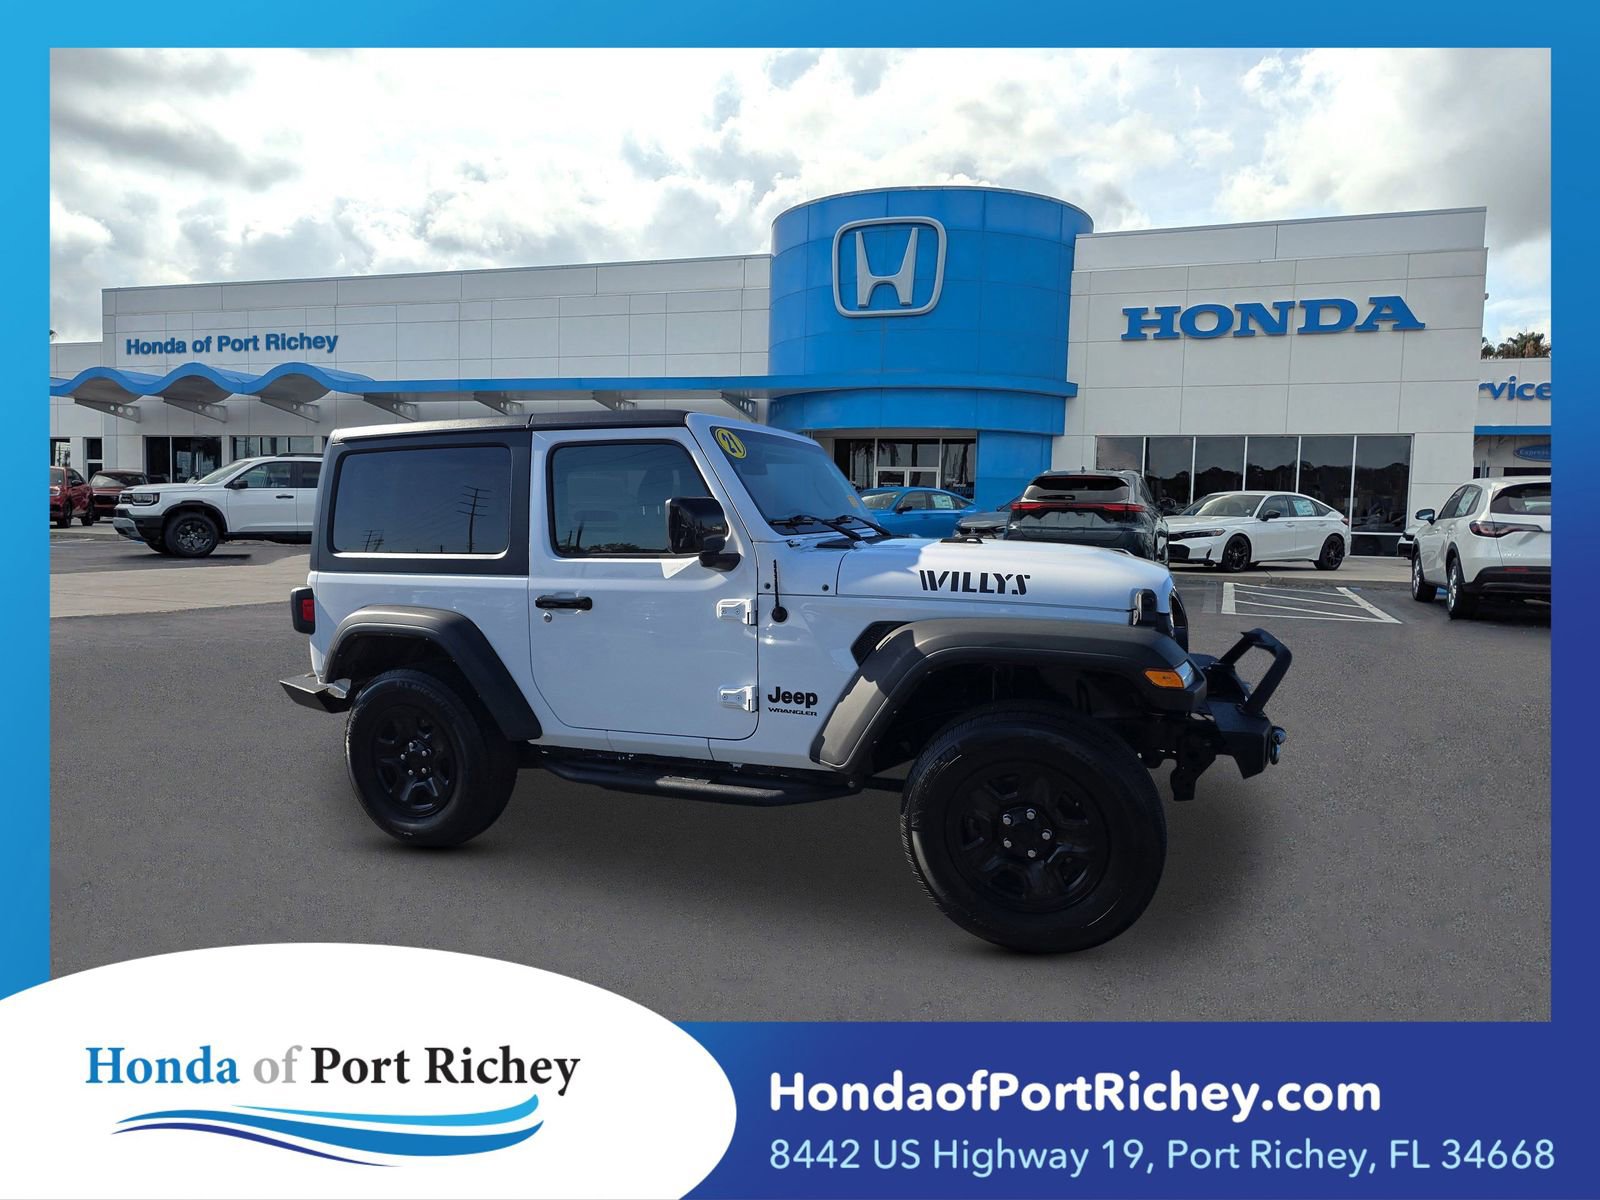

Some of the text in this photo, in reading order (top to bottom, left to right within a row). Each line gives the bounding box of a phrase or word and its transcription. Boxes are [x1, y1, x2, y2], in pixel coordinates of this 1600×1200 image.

[1121, 295, 1426, 341] HONDA
[126, 332, 338, 355] Honda of Port Richey
[919, 569, 1031, 596] WILLYS
[767, 686, 819, 709] Jeep
[767, 706, 818, 717] WRANGLER
